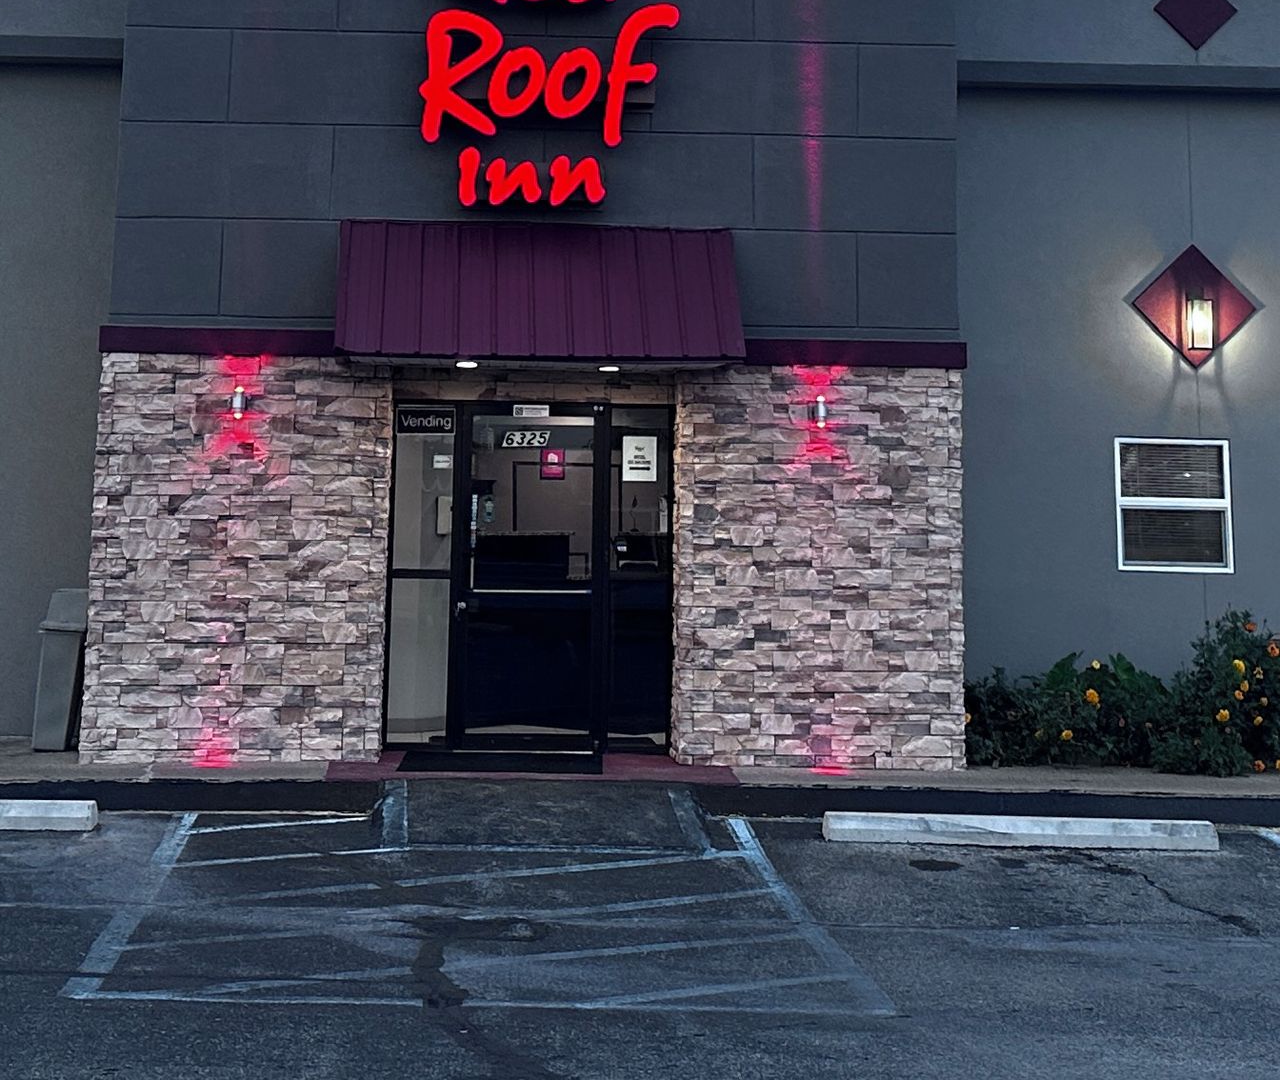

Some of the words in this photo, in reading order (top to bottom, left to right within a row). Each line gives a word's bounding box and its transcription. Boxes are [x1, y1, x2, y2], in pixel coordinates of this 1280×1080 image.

[420, 3, 680, 146] Roof
[458, 146, 606, 206] Inn
[401, 414, 452, 430] Vending
[505, 431, 548, 446] 6325
